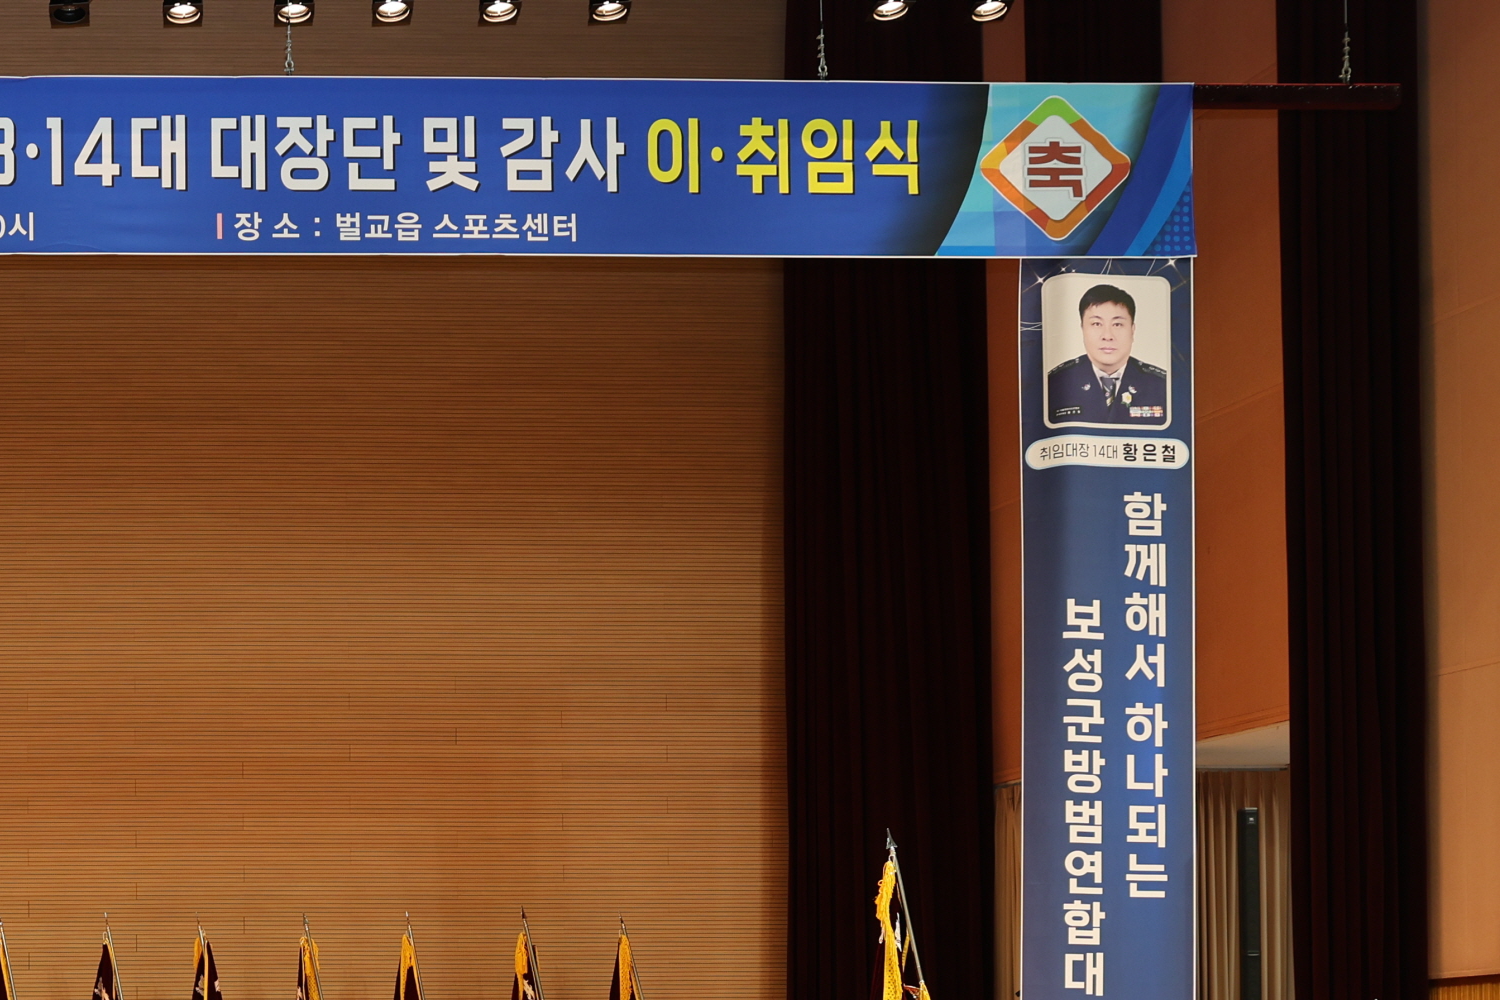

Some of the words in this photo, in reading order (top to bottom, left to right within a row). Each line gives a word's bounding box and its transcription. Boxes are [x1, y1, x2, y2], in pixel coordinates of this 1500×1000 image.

[211, 114, 401, 191] 대장단
[423, 116, 480, 192] 및
[500, 116, 625, 193] 감사
[646, 117, 920, 195] 이·취임식
[1028, 140, 1084, 200] 축
[335, 212, 423, 242] 벌교읍
[433, 212, 579, 242] 스포츠센터
[1039, 443, 1090, 461] 취임대장
[1093, 444, 1118, 459] 14대
[1123, 491, 1168, 688] 함께해서
[1062, 598, 1106, 997] 보성군방범연합대
[1125, 702, 1169, 899] 하나되는
